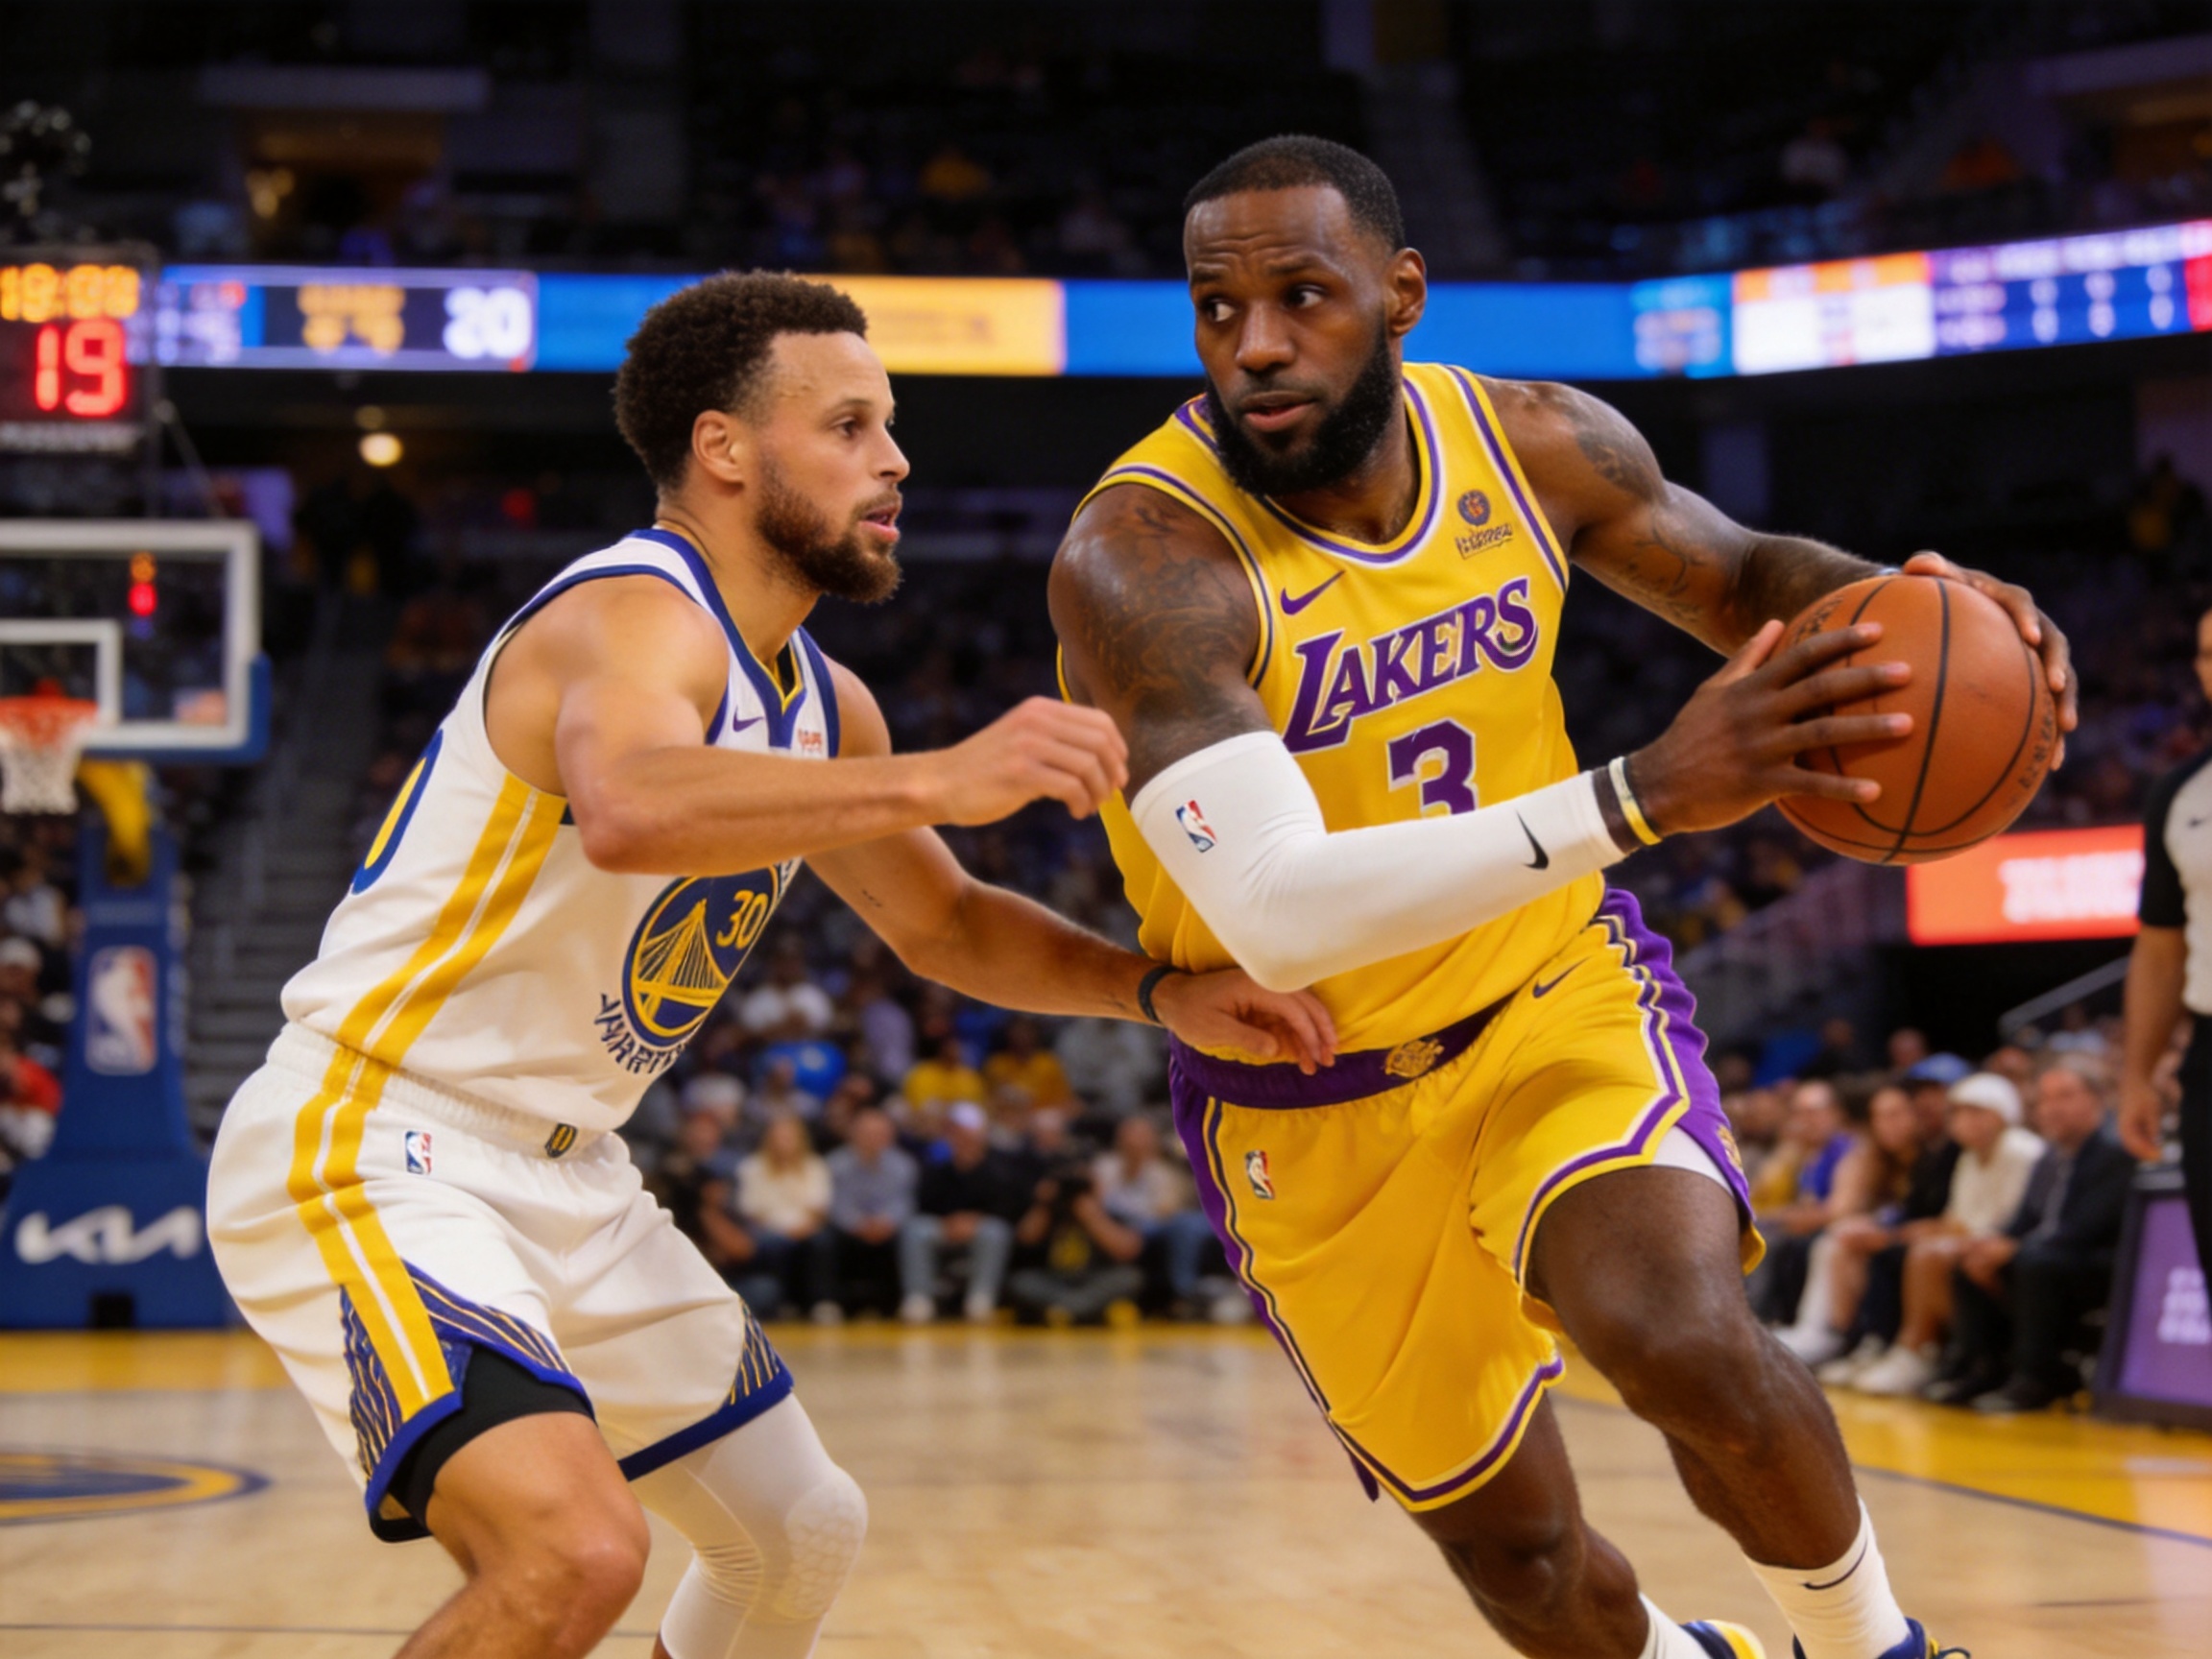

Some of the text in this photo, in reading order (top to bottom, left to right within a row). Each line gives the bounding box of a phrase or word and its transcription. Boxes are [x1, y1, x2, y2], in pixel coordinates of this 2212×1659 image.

[36, 319, 127, 417] 19
[1282, 575, 1538, 755] LAKERS
[1386, 717, 1479, 819] 3
[716, 889, 769, 950] 30
